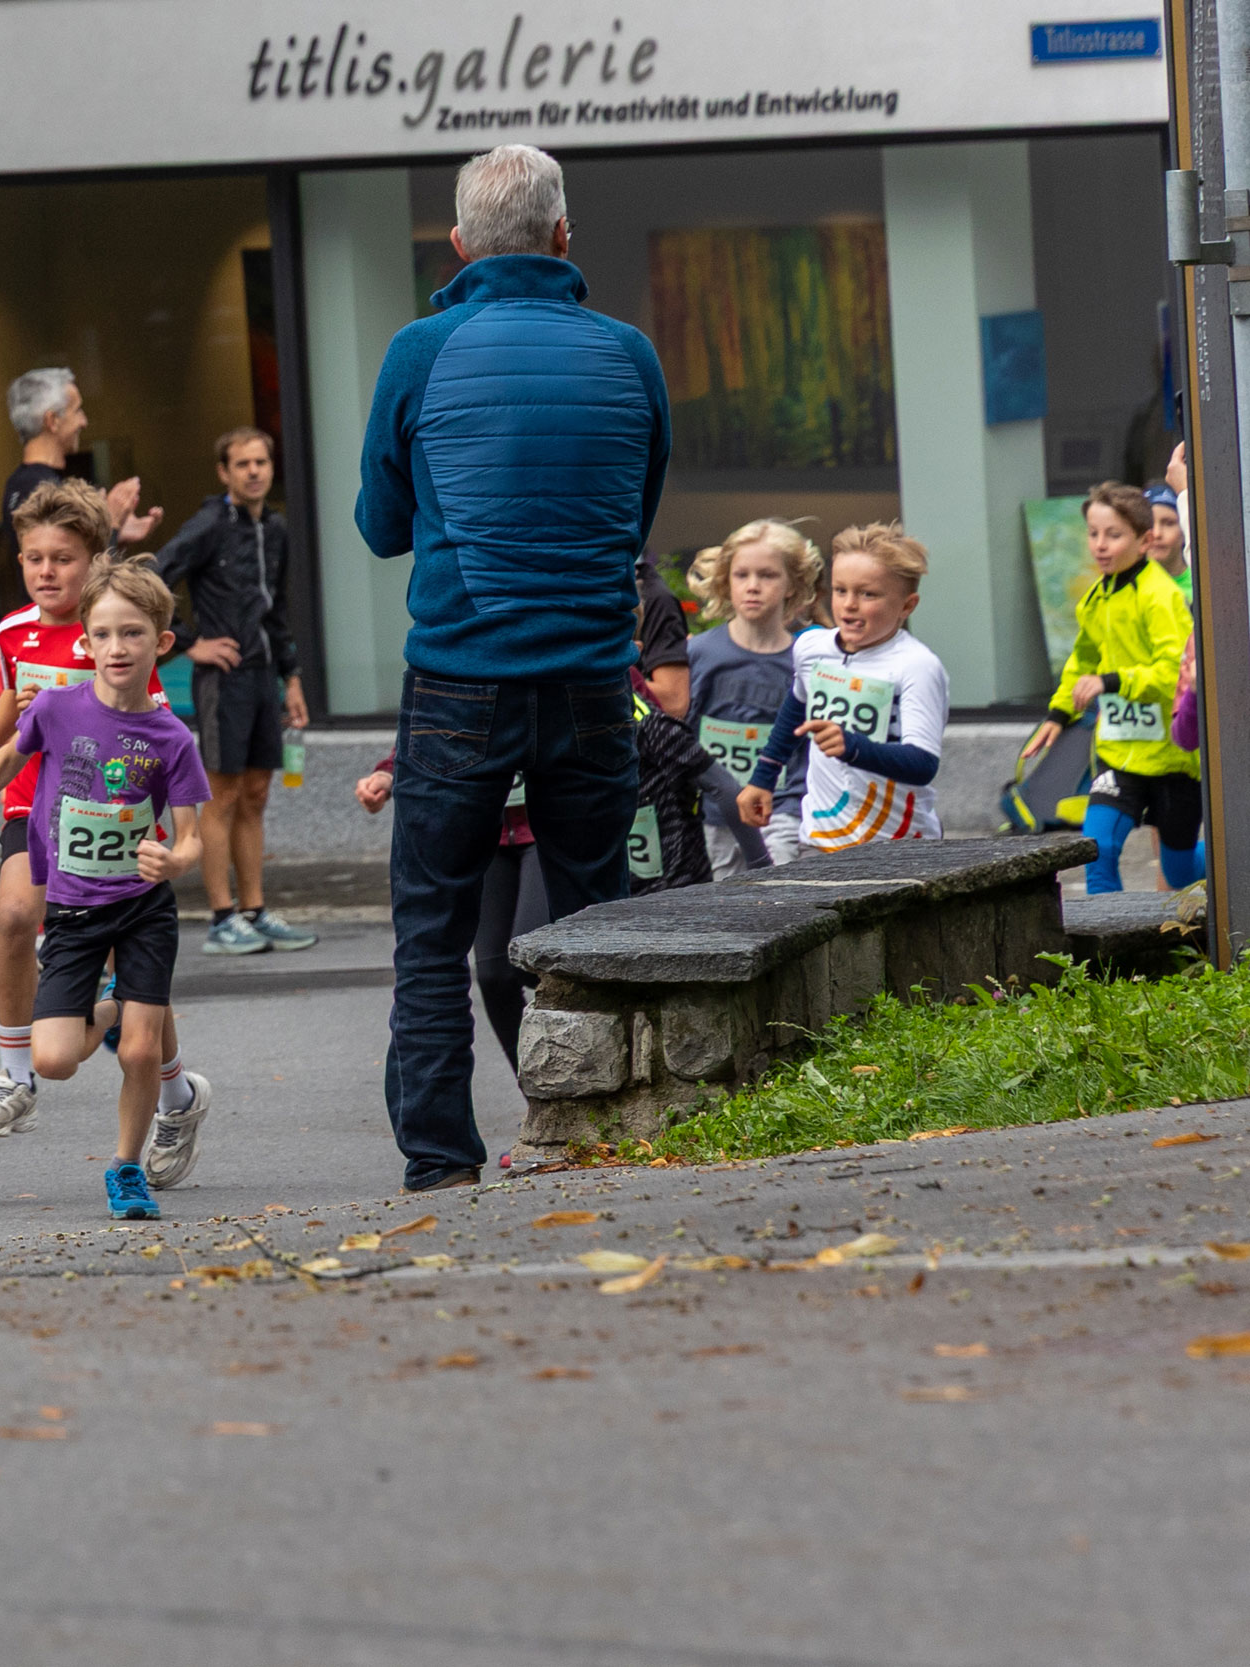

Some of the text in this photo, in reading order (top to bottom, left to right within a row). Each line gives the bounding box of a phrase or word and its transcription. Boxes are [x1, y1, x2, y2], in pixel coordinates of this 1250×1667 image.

[1044, 27, 1145, 53] Titlisstrasse
[249, 14, 657, 128] titlis.galerie
[436, 86, 899, 131] Zentrum für Kreativität und Entwicklung
[810, 690, 879, 736] 229
[1106, 702, 1157, 727] 245
